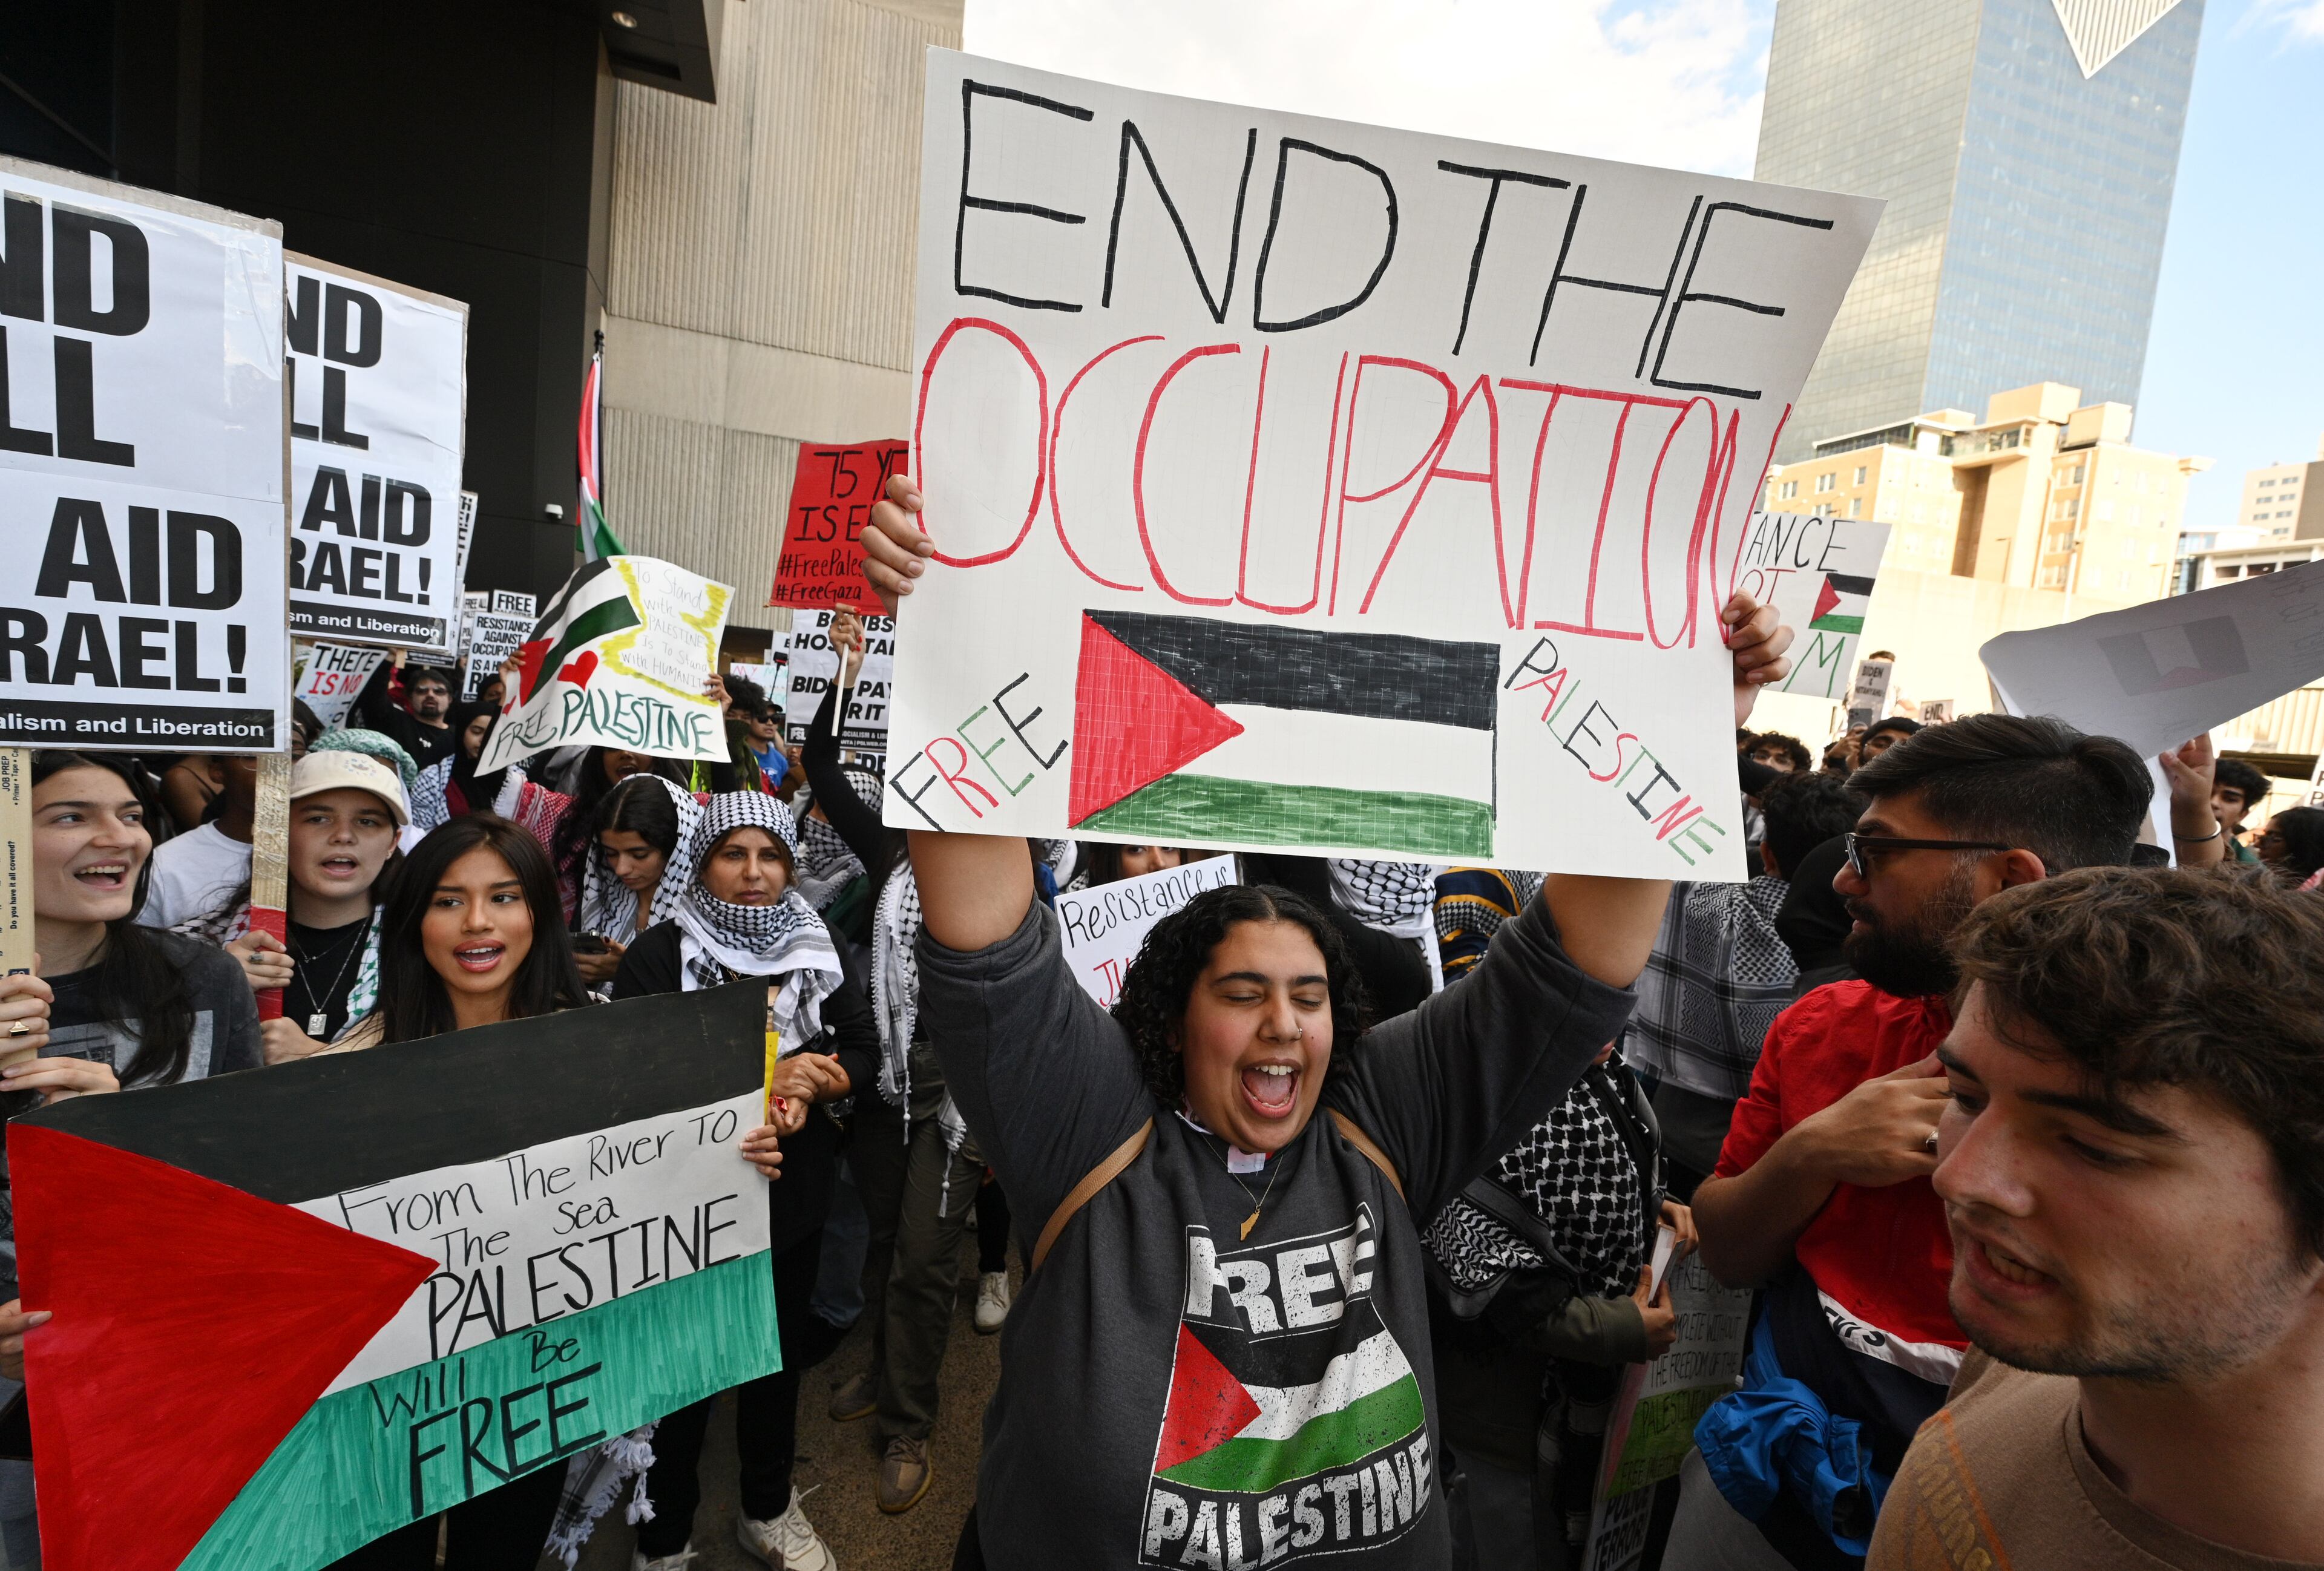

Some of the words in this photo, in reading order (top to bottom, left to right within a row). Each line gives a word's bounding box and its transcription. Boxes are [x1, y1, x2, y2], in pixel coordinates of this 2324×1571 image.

[956, 79, 1397, 332] END
[1438, 159, 1834, 400] THE
[813, 451, 862, 498] 75
[914, 317, 1792, 652] OCCUPATION
[301, 465, 431, 546] AID
[794, 505, 838, 542] IS
[34, 497, 242, 610] AID
[1745, 513, 1856, 572] ANCE
[497, 594, 532, 612] FREE
[631, 562, 651, 583] To
[659, 569, 703, 611] Stand
[776, 582, 862, 602] #FreeGaza
[318, 616, 350, 628] and
[357, 617, 439, 637] Liberation
[477, 616, 532, 633] RESISTANCE
[484, 631, 522, 644] AGAINST
[648, 614, 705, 648] PALESTINE
[816, 612, 893, 632] BBS
[472, 643, 517, 657] OCCUPAT
[472, 659, 482, 671] IS
[484, 660, 490, 671] A
[662, 641, 672, 656] To
[308, 672, 339, 695] IS
[338, 674, 363, 695] NO
[654, 658, 708, 690] HUMANIT
[1862, 665, 1884, 678] BIDEN
[76, 718, 126, 733] and
[137, 718, 264, 737] Liberation
[489, 702, 556, 766] FREE
[559, 688, 716, 755] PALESTINE
[865, 704, 885, 721] IT
[1, 756, 10, 775] PREP
[888, 672, 1069, 832] FREE
[1504, 637, 1726, 866] PALESTINE
[2, 777, 10, 792] JOB
[10, 920, 17, 929] Do
[1060, 869, 1207, 948] Resistance
[338, 1181, 482, 1233] From
[496, 1153, 576, 1205] The
[587, 1130, 674, 1181] River
[430, 1227, 510, 1272] The
[424, 1194, 741, 1360] PALESTINE
[1187, 1214, 1375, 1333] FREE
[524, 1331, 580, 1373] Be
[1650, 1353, 1669, 1388] THE
[1669, 1352, 1708, 1382] FREEDOM
[1708, 1352, 1721, 1377] OF
[410, 1362, 606, 1520] FREE
[1145, 1431, 1431, 1571] PALESTINE
